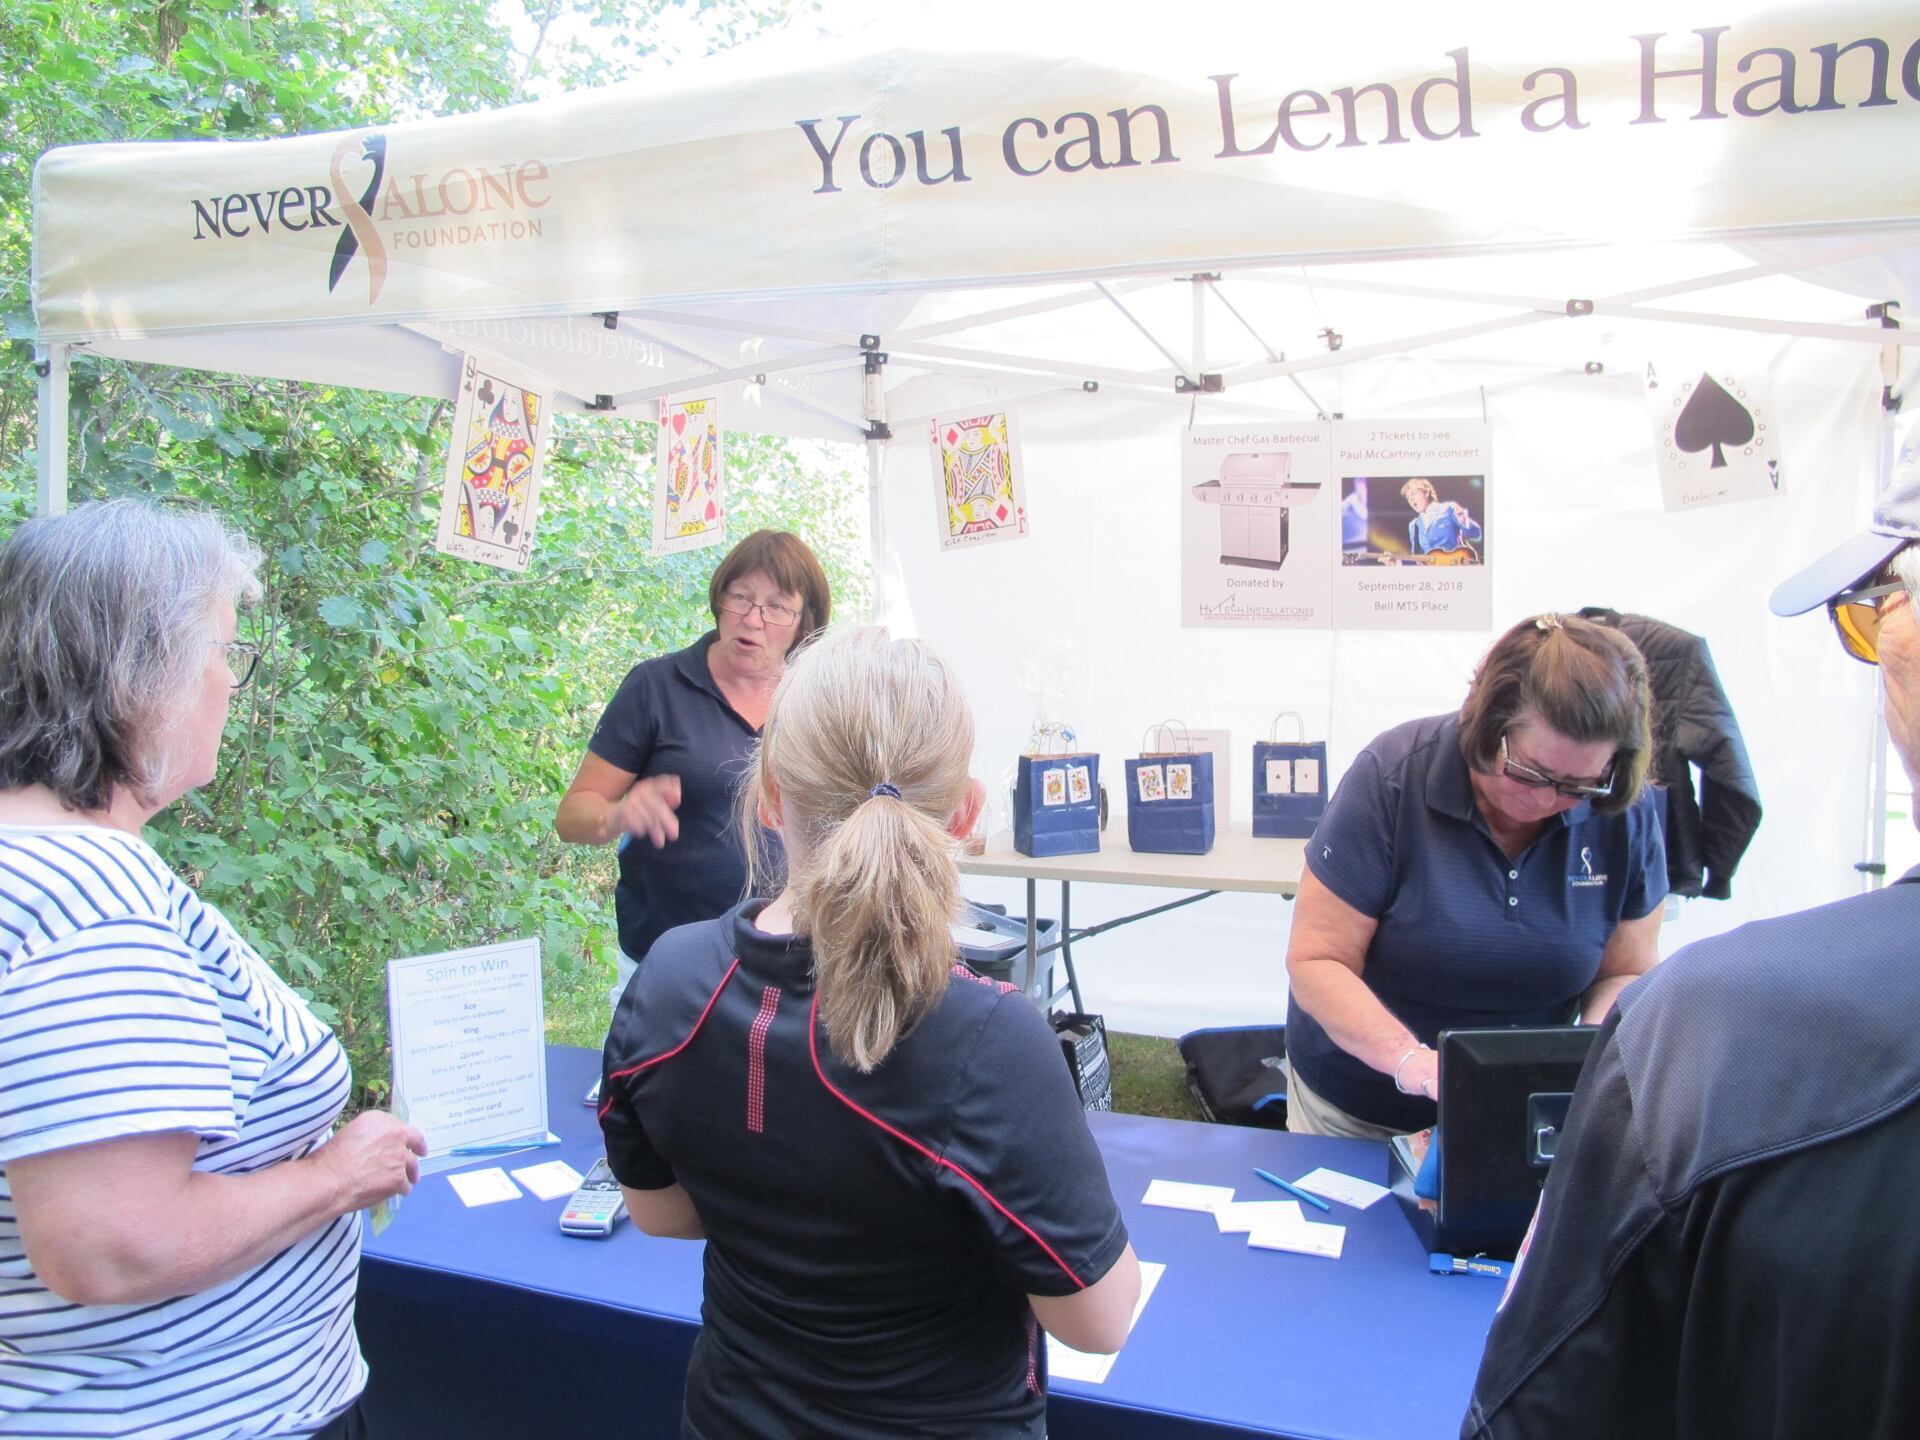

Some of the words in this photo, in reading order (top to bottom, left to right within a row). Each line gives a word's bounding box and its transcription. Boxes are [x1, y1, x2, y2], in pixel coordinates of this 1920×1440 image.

[795, 114, 972, 194] You
[1002, 104, 1181, 178] can
[1207, 46, 1481, 159] Lend
[1520, 66, 1591, 133] a
[1628, 25, 1920, 125] Han
[393, 219, 542, 250] FOUNDATION
[1647, 361, 1656, 378] A
[1192, 436, 1225, 446] Master
[1227, 434, 1250, 445] Chef
[1251, 434, 1270, 444] Gas
[1272, 433, 1320, 444] Barbecue
[1370, 432, 1376, 441] 2
[1379, 431, 1416, 441] Tickets
[1419, 431, 1429, 440] to
[1433, 432, 1450, 440] see
[1340, 449, 1362, 460] Paul
[1365, 449, 1422, 460] McCartney
[1425, 449, 1435, 458] in
[1438, 448, 1479, 458] concert
[1226, 578, 1269, 588] Donated
[1272, 578, 1285, 590] by
[1358, 581, 1415, 592] September
[1418, 581, 1434, 592] 28,
[1438, 581, 1463, 591] 2018
[1374, 601, 1394, 611] Bell
[1396, 601, 1419, 611] MTS
[1421, 601, 1449, 611] Place
[426, 965, 457, 984] Spin
[462, 963, 477, 976] to
[481, 957, 509, 972] Win
[464, 1026, 480, 1035] King
[460, 1049, 485, 1059] Queen
[466, 1074, 481, 1082] Jack
[448, 1111, 463, 1120] Any
[465, 1106, 484, 1115] other
[486, 1101, 502, 1110] card
